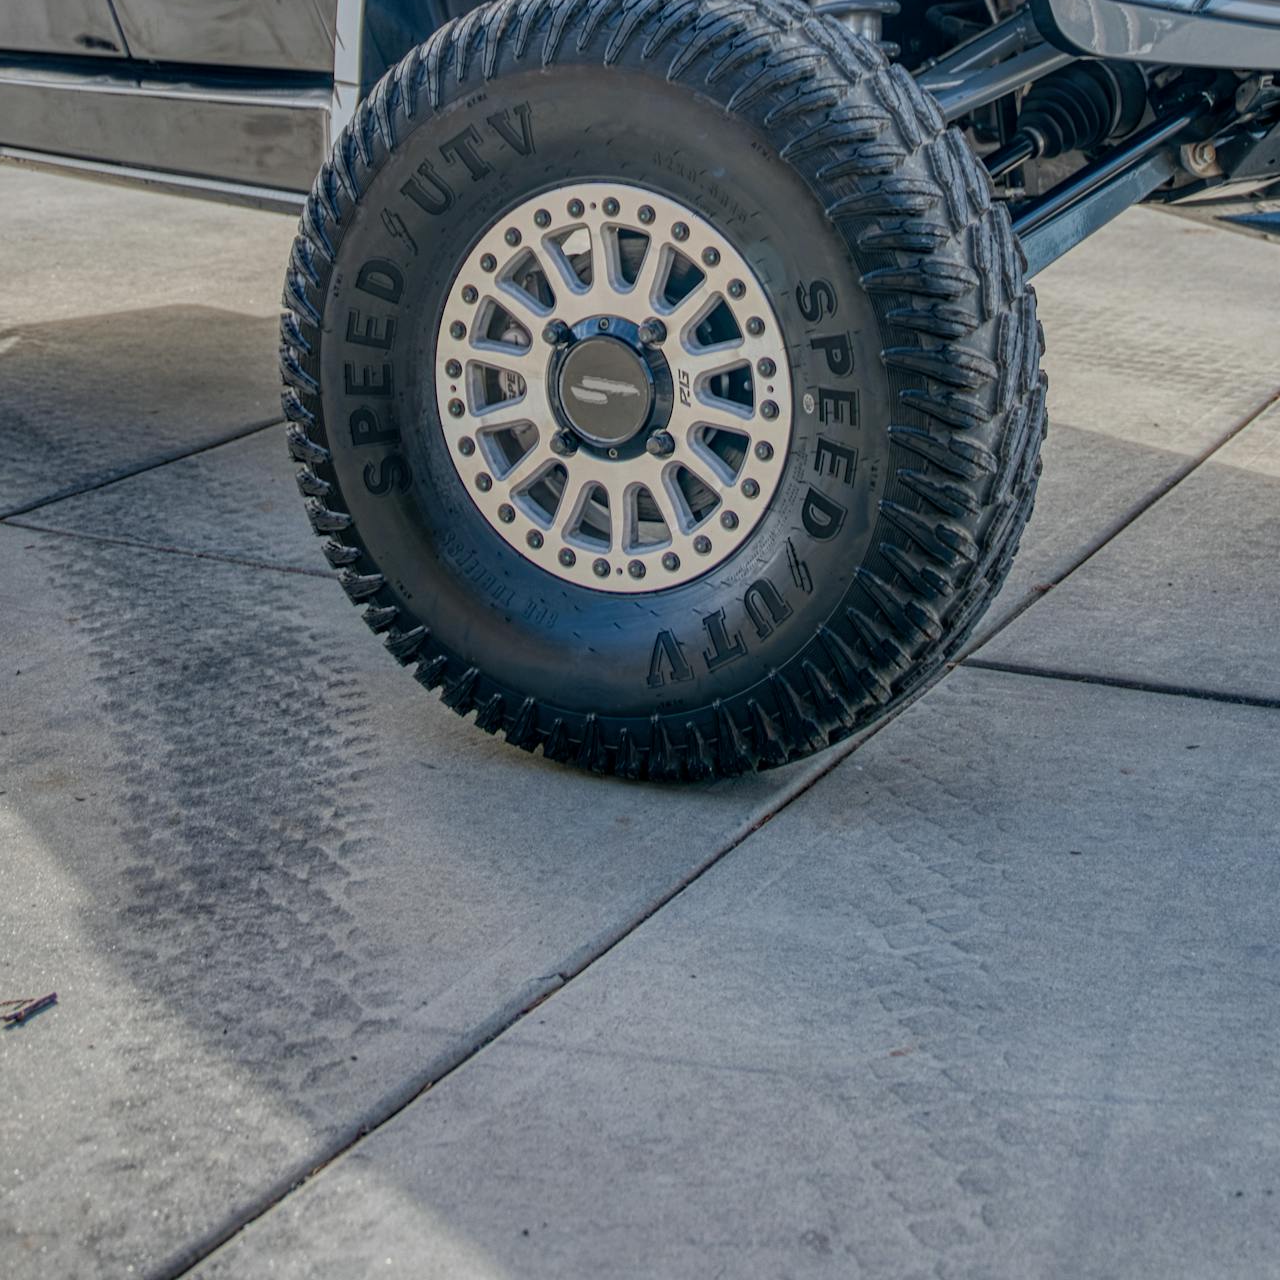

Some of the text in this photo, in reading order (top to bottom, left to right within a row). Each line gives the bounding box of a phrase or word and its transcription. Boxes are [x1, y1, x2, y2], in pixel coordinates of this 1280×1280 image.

[345, 257, 412, 497] SPEED
[400, 101, 536, 216] UTV
[796, 279, 859, 542] SPEED
[647, 577, 794, 689] UTV
